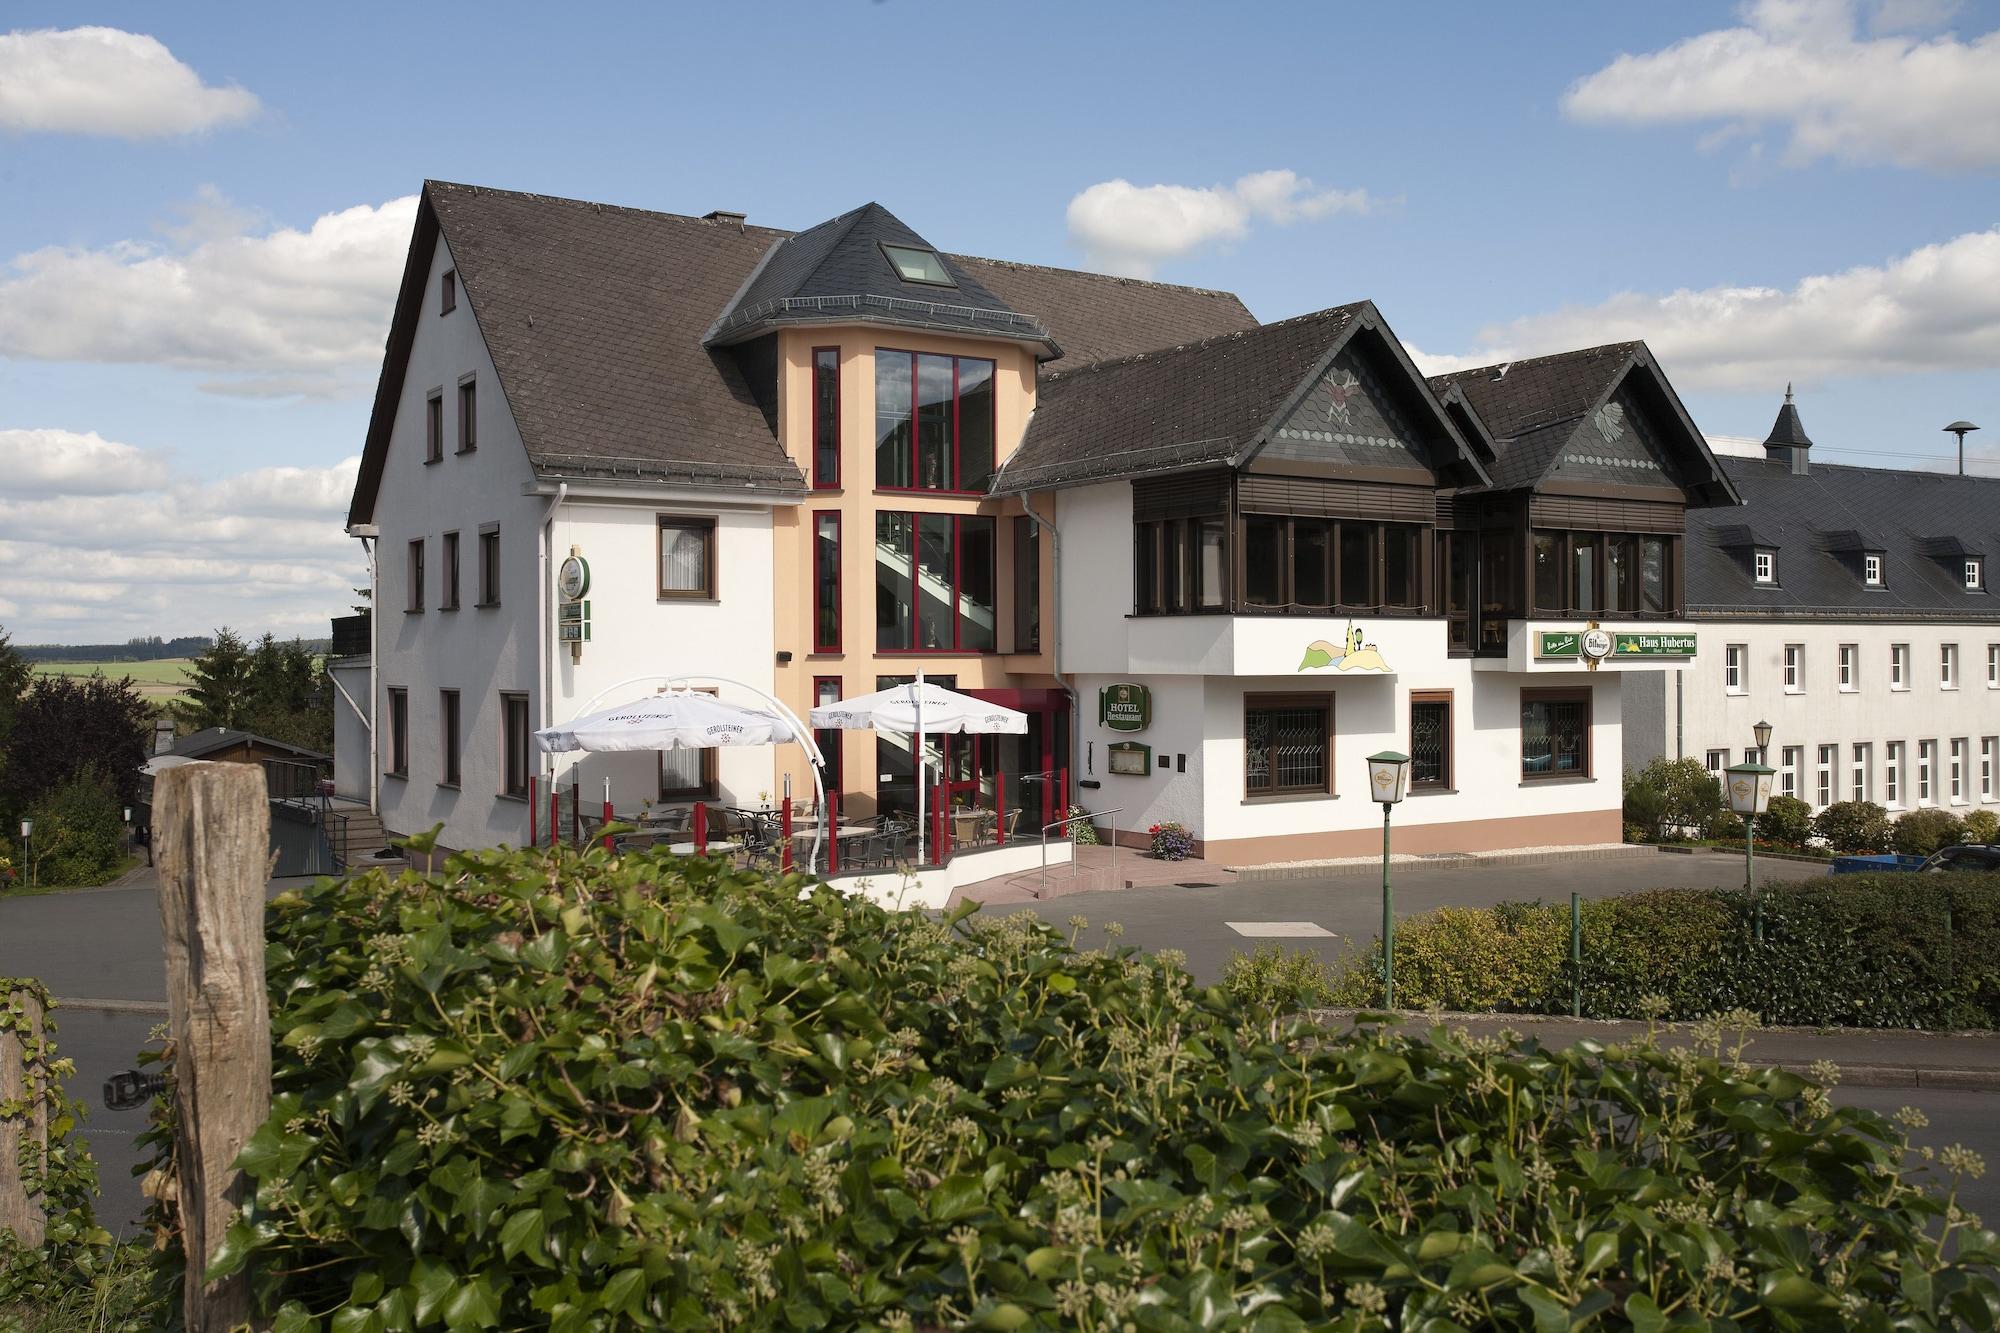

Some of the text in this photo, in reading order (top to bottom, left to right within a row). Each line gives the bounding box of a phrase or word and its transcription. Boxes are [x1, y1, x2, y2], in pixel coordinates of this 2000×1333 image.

[1588, 638, 1608, 649] Bitburger
[1639, 636, 1695, 648] Haus Hubertus
[1110, 703, 1139, 713] HOTEL
[608, 713, 672, 721] GEROLSTEINER
[1107, 711, 1142, 721] Restaurant
[706, 723, 744, 736] GEROLSTEINER
